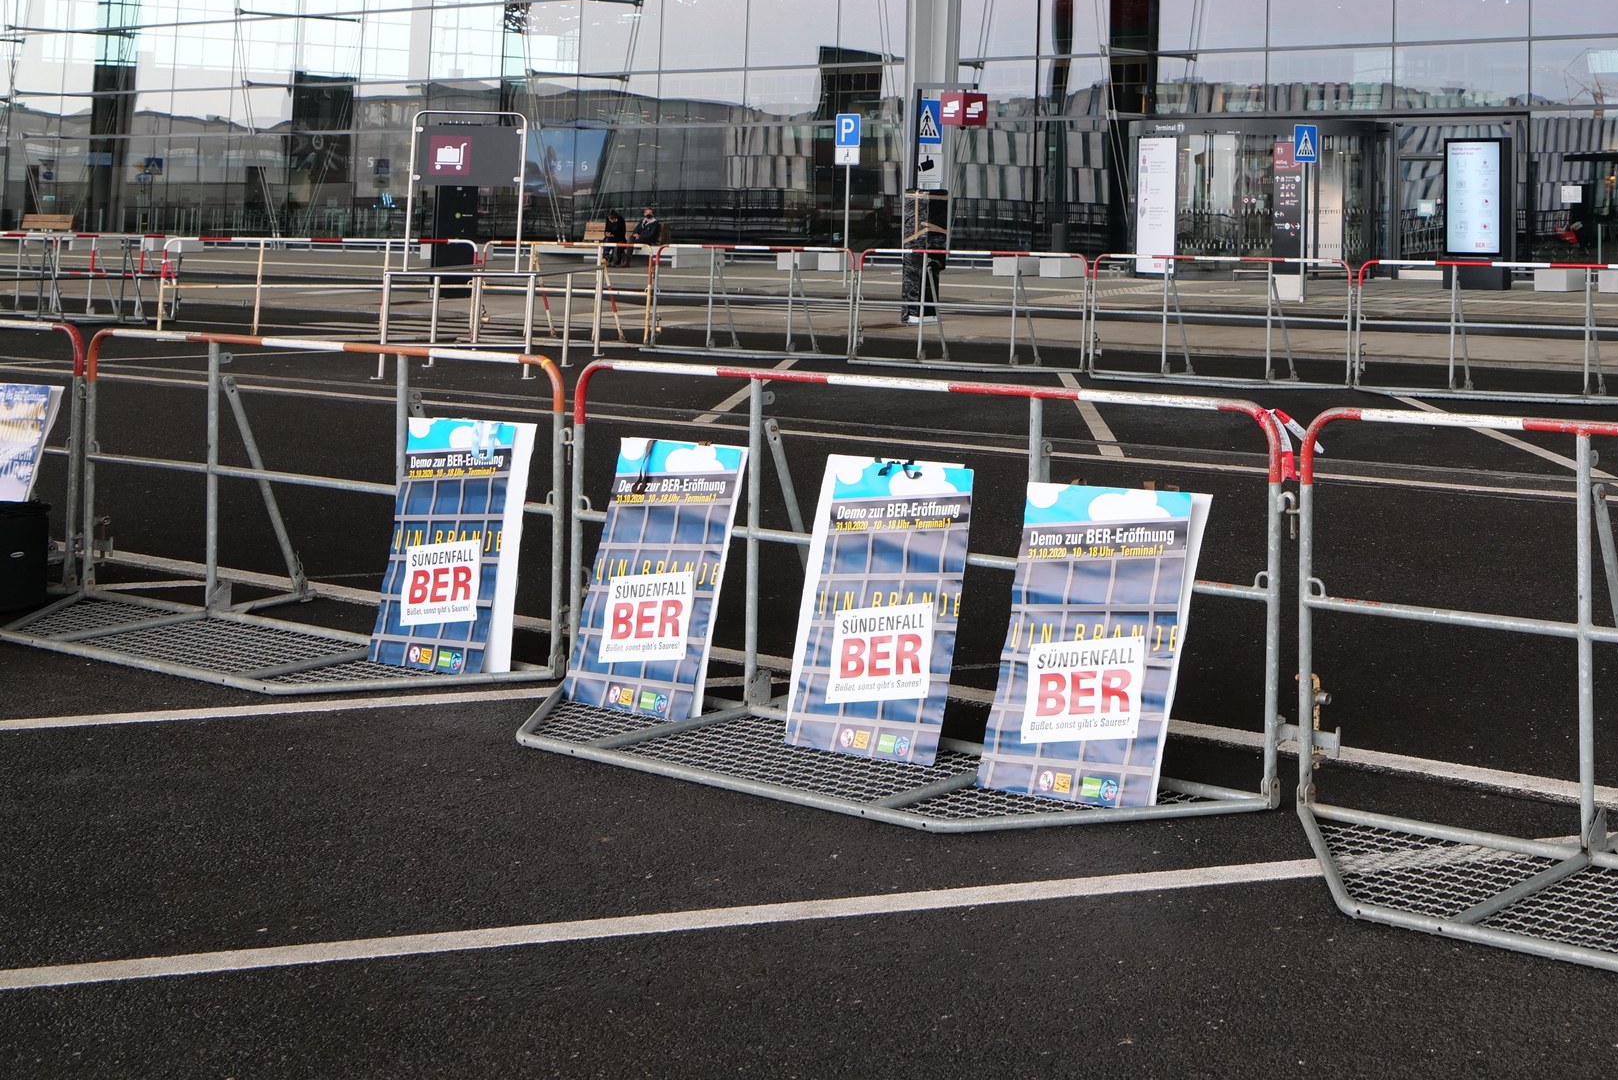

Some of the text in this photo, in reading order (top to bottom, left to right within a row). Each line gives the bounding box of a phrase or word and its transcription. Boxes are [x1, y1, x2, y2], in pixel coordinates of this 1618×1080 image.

[841, 118, 855, 142] P
[367, 157, 374, 168] 5
[410, 453, 504, 468] Demo zur BER-Erffung
[454, 468, 465, 477] Uhr
[468, 467, 492, 476] Terminal
[618, 478, 726, 494] De zur BER-Eröffnung
[616, 494, 645, 504] 31.10.2020
[668, 493, 680, 503] Uhr
[684, 493, 712, 503] Terminal
[837, 501, 960, 519] Demo zur BER-Eröffnung
[835, 520, 868, 531] 31.10.2020
[873, 520, 882, 530] 10
[888, 520, 897, 530] 18
[898, 519, 910, 529] Uhr
[914, 518, 946, 529] Terminal
[1030, 527, 1175, 546] Demo zur BER-Eröffnung
[412, 549, 474, 567] SÜNDENFALL
[1027, 547, 1067, 559] 31.10.2020
[1072, 547, 1083, 557] 10
[1088, 546, 1098, 557] 18
[1100, 545, 1114, 557] Uhr
[1120, 544, 1157, 556] Terminal
[408, 566, 472, 605] BER
[615, 581, 687, 599] SÜNDENFALL
[423, 607, 436, 615] sonst
[451, 604, 470, 613] Saures!
[818, 591, 854, 614] LIN
[610, 599, 683, 640] BER
[842, 613, 924, 634] SÜNDENFALL
[1010, 622, 1053, 648] LIN
[625, 643, 641, 651] sonst
[659, 641, 680, 650] Saures!
[840, 633, 922, 679] BER
[1037, 648, 1135, 670] SÜNDENFALL
[857, 682, 876, 691] sonst
[876, 680, 895, 692] gibt's
[896, 678, 921, 689] Saures!
[1036, 669, 1132, 717] BER
[1030, 717, 1130, 731] Büßet, sonst gibt's Saures!
